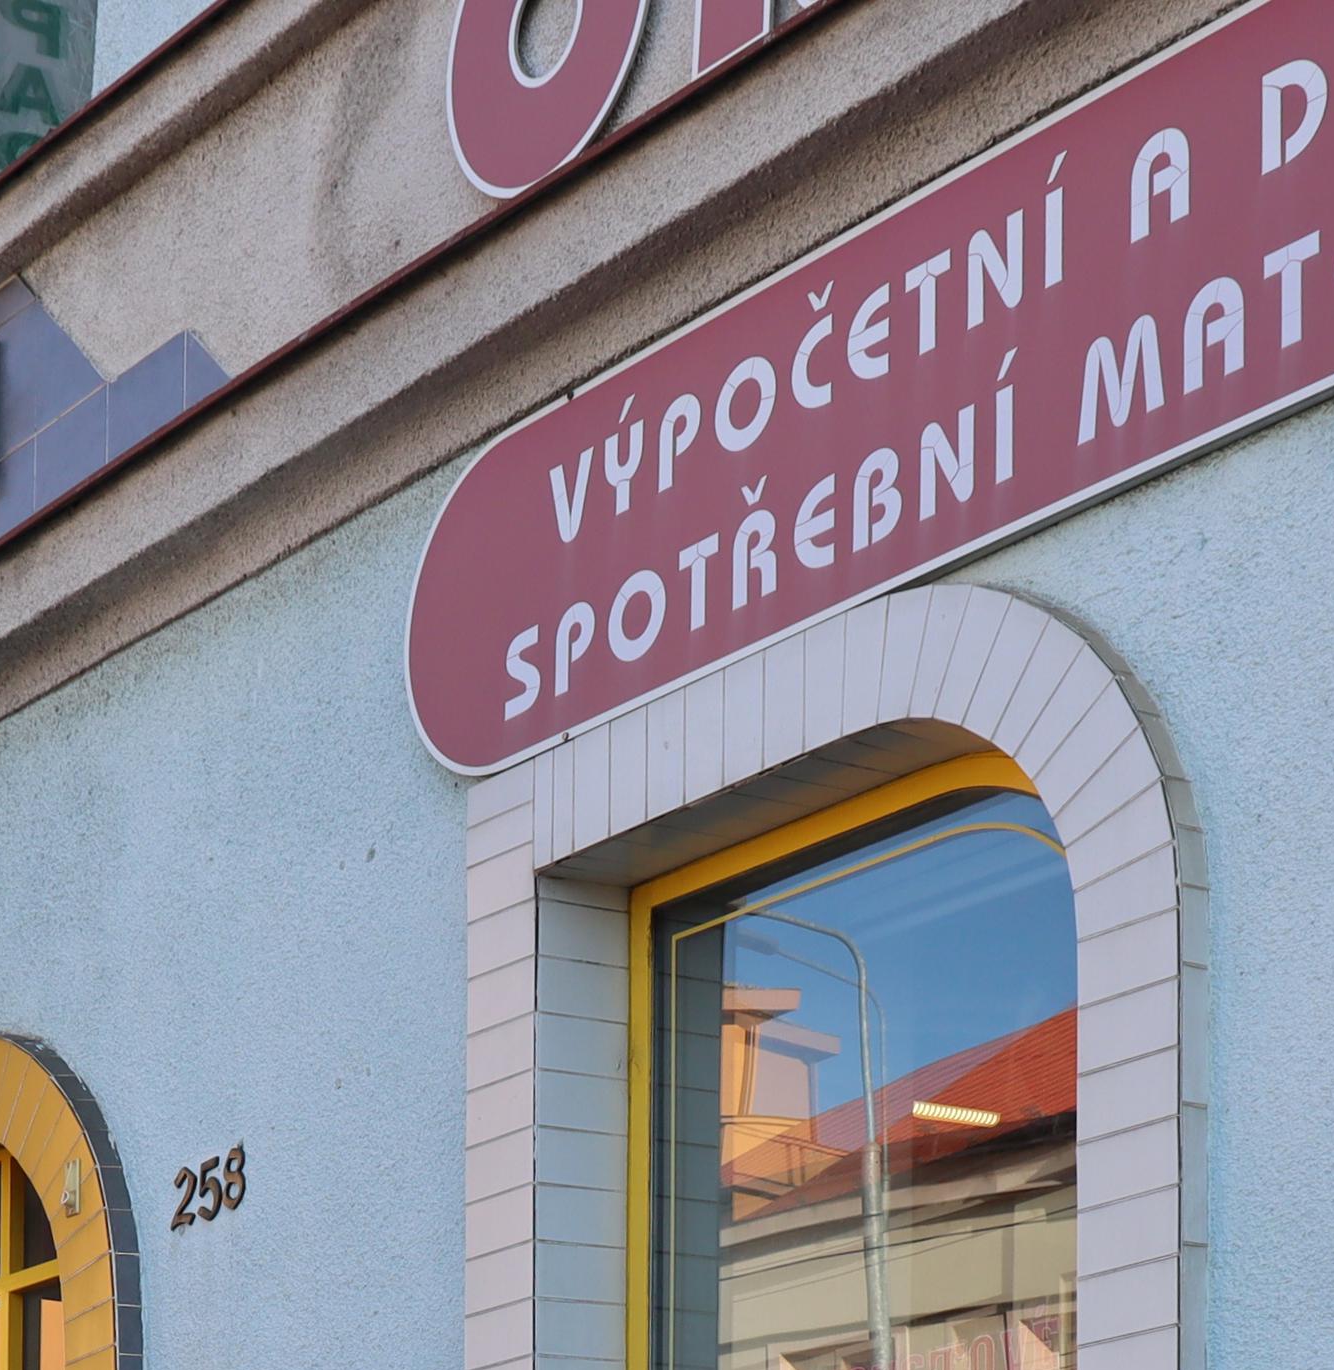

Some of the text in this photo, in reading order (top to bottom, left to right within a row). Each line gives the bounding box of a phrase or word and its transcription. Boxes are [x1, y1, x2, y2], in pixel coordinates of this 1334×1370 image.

[548, 150, 1068, 543] VÝPOČETNÍ
[1131, 127, 1191, 245] A
[503, 348, 1018, 722] SPOTŘEBNÍ
[170, 1147, 247, 1232] 258
